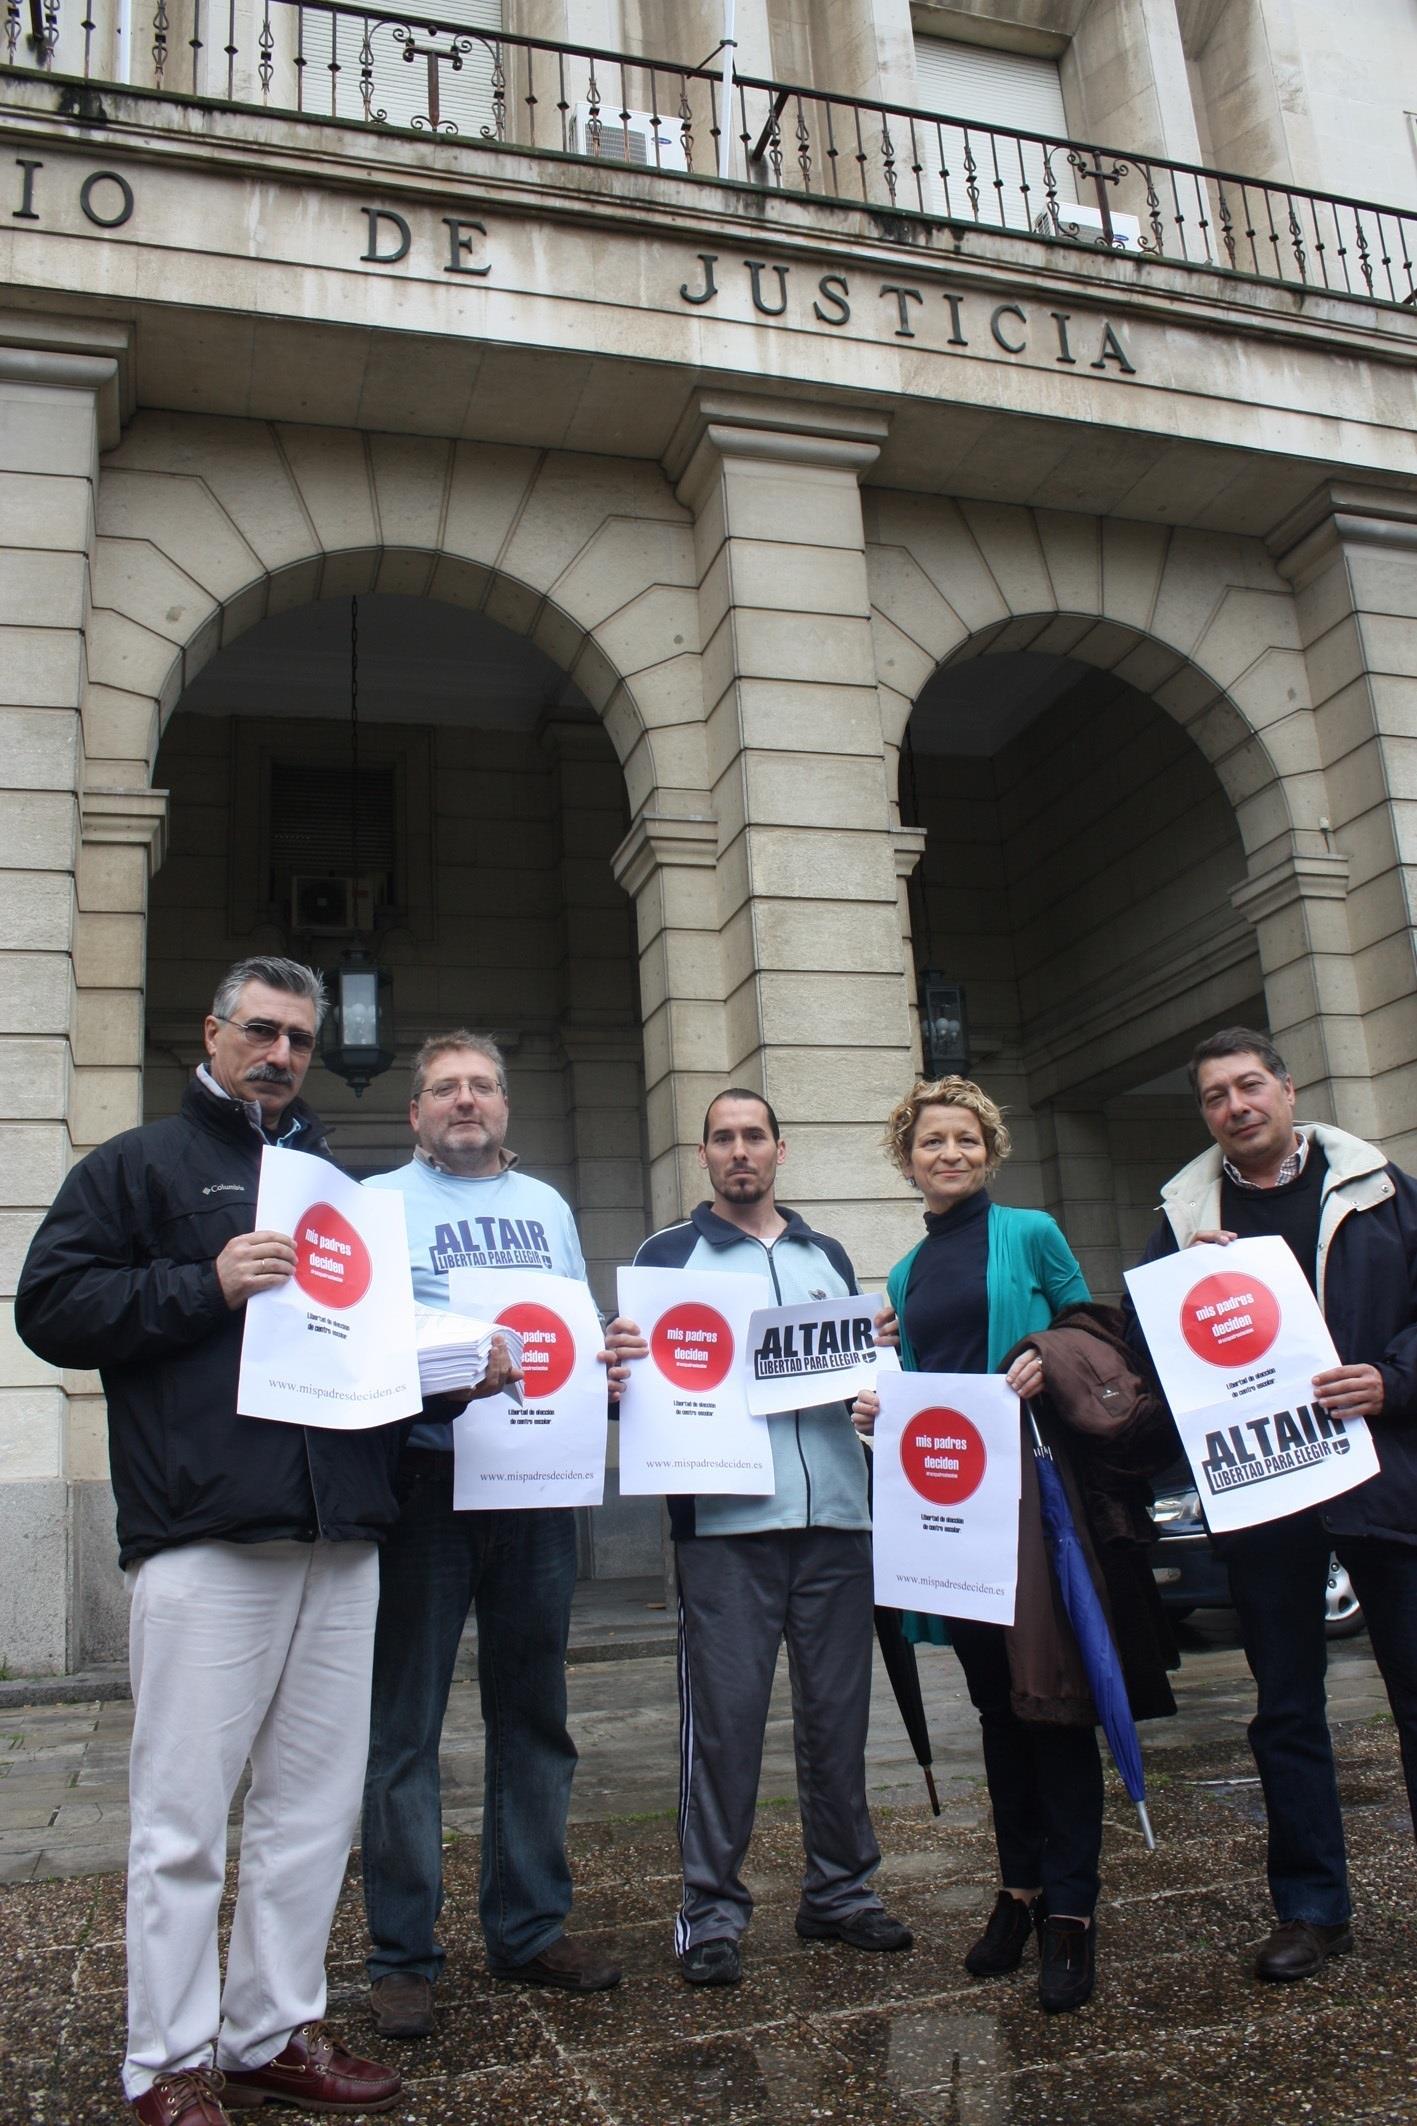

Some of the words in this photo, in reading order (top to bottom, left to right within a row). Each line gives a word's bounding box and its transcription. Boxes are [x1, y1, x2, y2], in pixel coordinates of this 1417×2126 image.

[360, 206, 492, 276] DE
[679, 254, 1137, 374] JUSTICIA
[305, 1228, 319, 1245] mis
[319, 1236, 352, 1256] padres
[434, 1216, 549, 1255] ALTAIR
[309, 1252, 344, 1275] deciden
[438, 1252, 487, 1269] LIBERTAD
[488, 1250, 514, 1264] PARA
[1196, 1306, 1216, 1321] mis
[1216, 1293, 1254, 1315] padres
[523, 1330, 557, 1344] padres
[667, 1328, 684, 1341] mis
[685, 1330, 718, 1343] padres
[1212, 1315, 1253, 1337] deciden
[760, 1317, 875, 1360] ALTAIR
[674, 1347, 708, 1361] deciden
[760, 1358, 802, 1375] LIBERTAD
[804, 1355, 829, 1371] PARA
[830, 1352, 861, 1367] ELEGIR
[268, 1379, 408, 1401] www.mispadresdeciden.es
[916, 1435, 932, 1448] mis
[934, 1436, 967, 1450] padres
[1205, 1401, 1347, 1472] ALTAIR
[646, 1459, 763, 1470] www.mispadresdeciden.es
[924, 1455, 959, 1471] deciden
[1212, 1461, 1264, 1488] LIBERTAD
[1264, 1451, 1295, 1473] PARA
[1295, 1440, 1332, 1464] ELEGIR
[480, 1470, 595, 1483] www.mispadresdeciden.es
[896, 1574, 1005, 1596] www.mispadresdeciden.es
